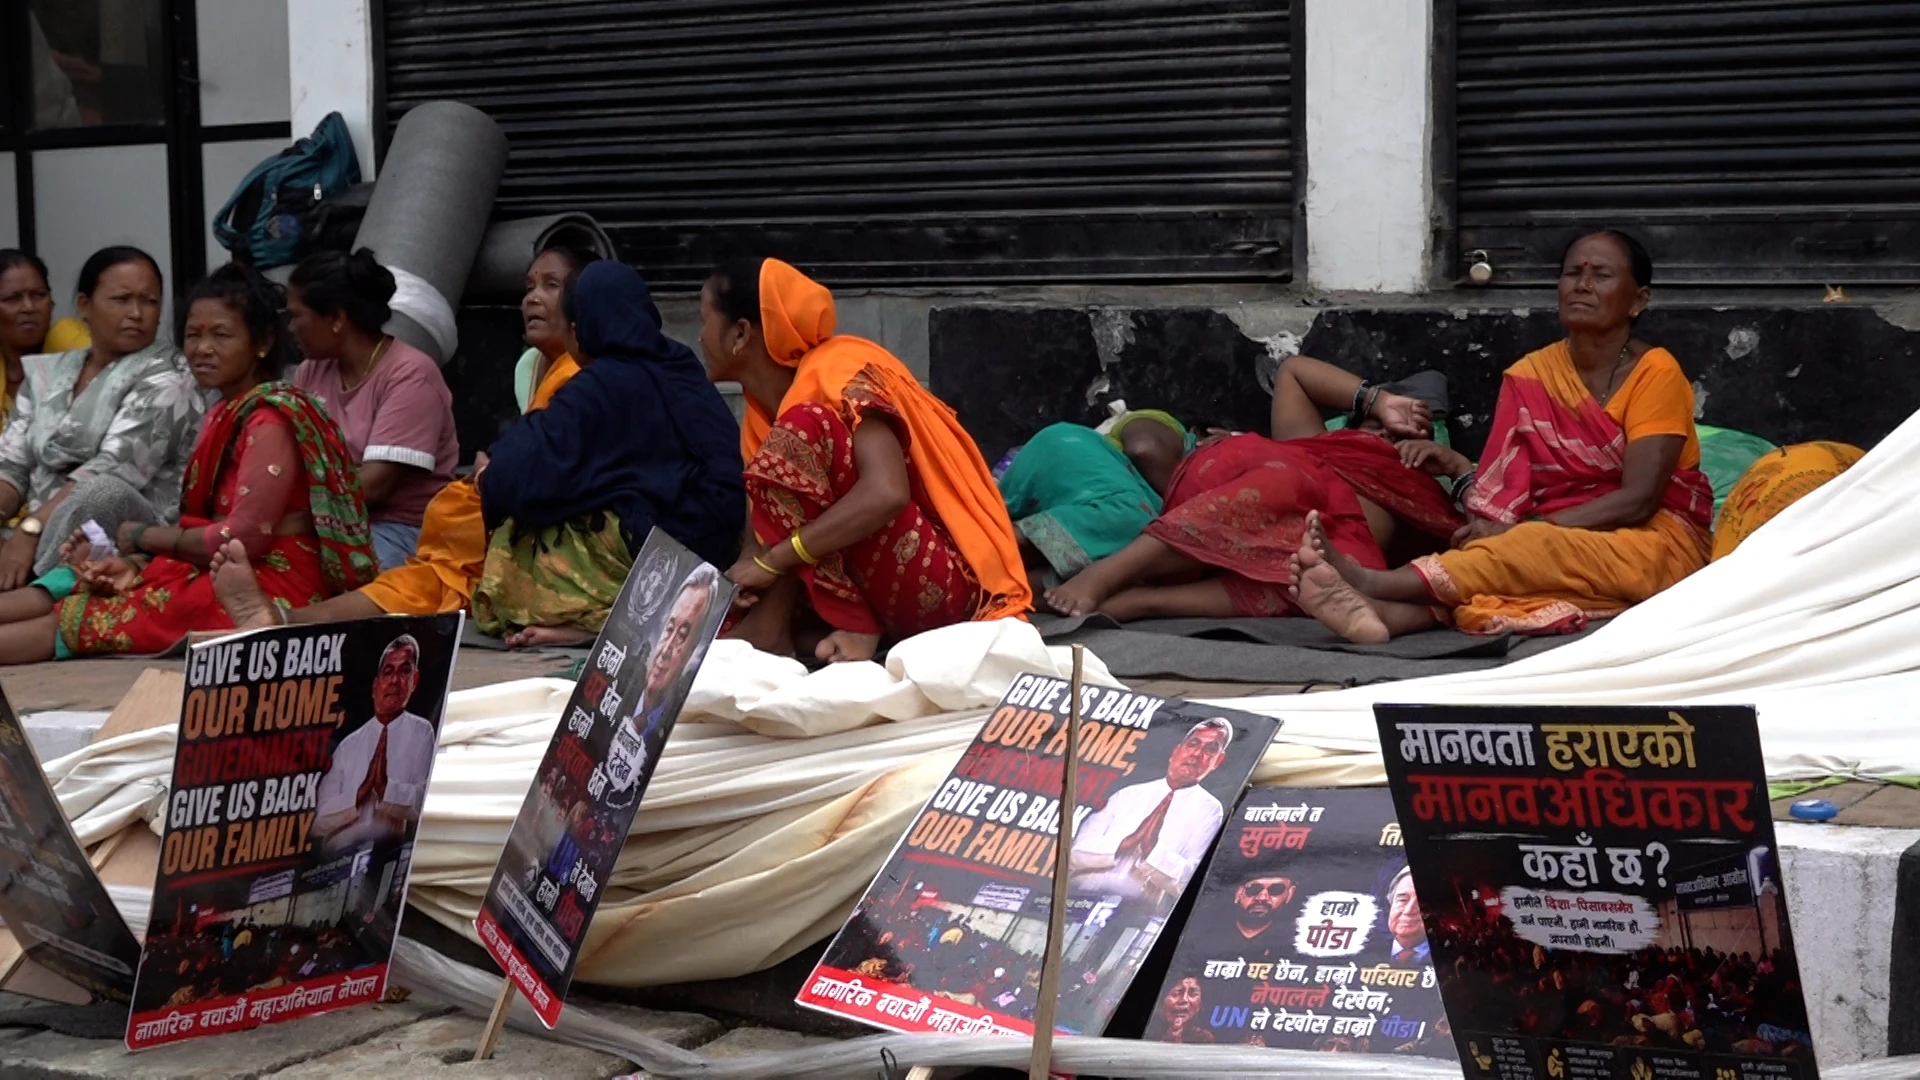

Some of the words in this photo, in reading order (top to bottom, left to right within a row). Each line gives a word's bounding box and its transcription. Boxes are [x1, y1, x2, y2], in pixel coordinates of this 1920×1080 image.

[189, 642, 244, 688] GIVE
[247, 639, 280, 682] US
[282, 633, 347, 678] BACK
[597, 639, 627, 678] हाम्रो
[183, 685, 249, 740] OUR
[253, 675, 346, 730] HOME,
[568, 705, 594, 740] हाम्रो
[1006, 675, 1069, 710] GIVE
[1091, 691, 1165, 730] BACK
[982, 705, 1055, 751] OUR
[1044, 717, 1147, 777] HOME,
[1396, 723, 1536, 767] मानवता
[1540, 711, 1697, 771] हराएको
[170, 785, 225, 829] GIVE
[226, 781, 259, 822] US
[260, 771, 322, 816] BACK
[933, 777, 995, 817] GIVE
[985, 789, 1027, 825] US
[1244, 802, 1309, 823] बालेनले
[1309, 806, 1325, 822] त
[1407, 767, 1755, 832] मानवअधिकार
[162, 826, 219, 875] OUR
[221, 811, 316, 866] FAMILY.
[907, 810, 974, 855] OUR
[1239, 820, 1312, 859] सुनेन
[1518, 831, 1600, 887] कहाँ
[1320, 897, 1360, 917] हाम्रो
[1306, 918, 1357, 950] पीडा
[811, 976, 878, 1007] नागरिक
[1203, 956, 1246, 980] हाम्रो
[1247, 962, 1273, 980] घर
[1274, 958, 1308, 984] छैन,
[1313, 961, 1358, 986] हाम्रो
[1359, 963, 1419, 987] परिवार
[134, 1010, 197, 1042] नागरिक
[338, 975, 379, 1000] नेपाल
[1251, 981, 1330, 1009] नेपालले
[1209, 1005, 1249, 1029] UN
[1250, 1007, 1271, 1031] ले
[1272, 1007, 1331, 1034] देखोस
[1332, 1012, 1377, 1039] हाम्रो
